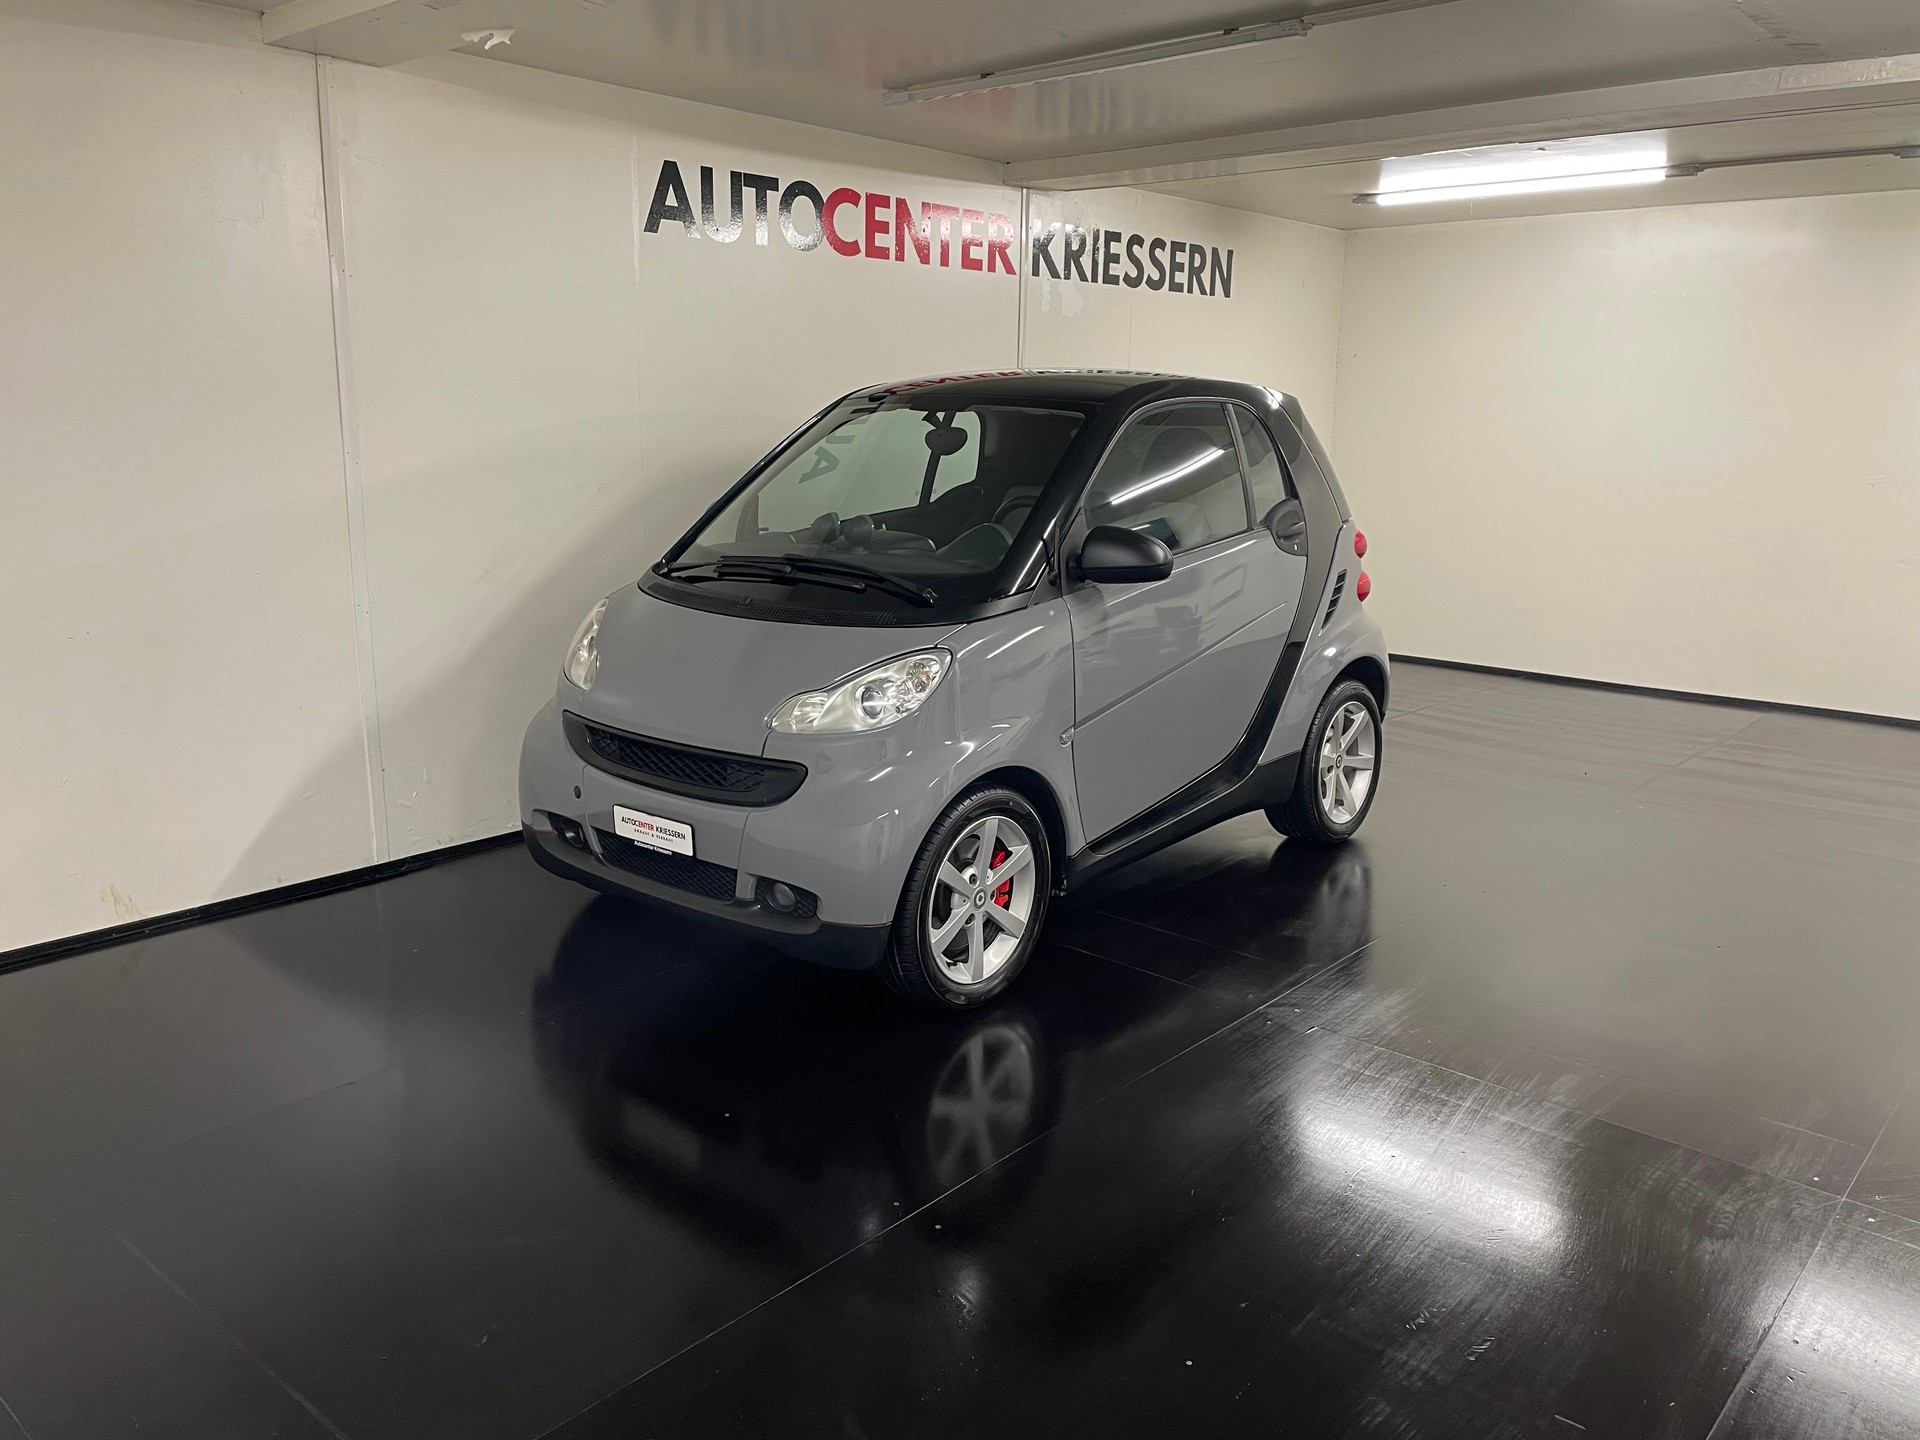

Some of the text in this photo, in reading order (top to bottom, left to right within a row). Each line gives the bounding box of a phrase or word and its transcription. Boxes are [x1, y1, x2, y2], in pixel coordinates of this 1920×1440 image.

[643, 159, 1234, 299] AUTOCENTER KRIESSERN
[621, 816, 686, 840] AUTOCENTER KRIESSERN
